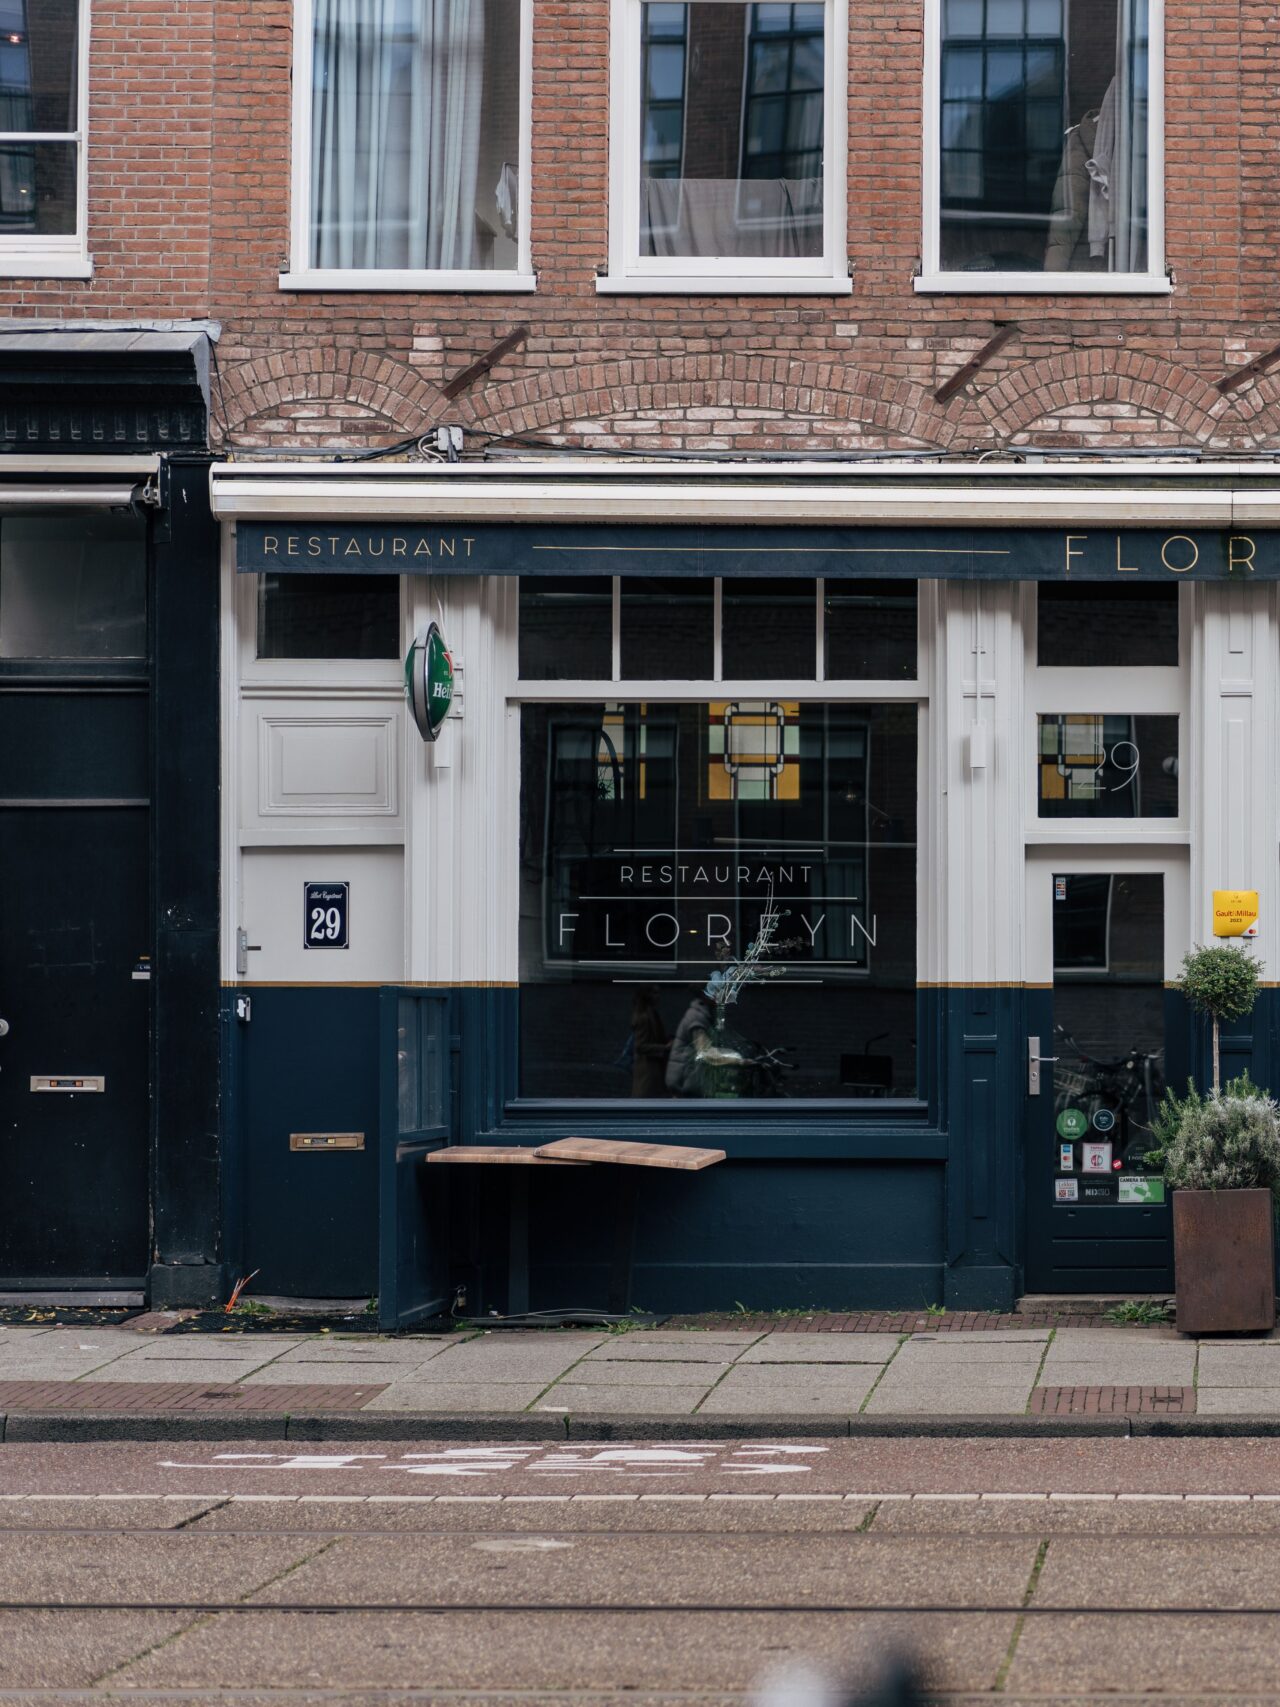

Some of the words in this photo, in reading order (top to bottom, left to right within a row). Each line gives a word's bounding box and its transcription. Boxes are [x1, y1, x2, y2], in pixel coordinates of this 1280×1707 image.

[263, 536, 476, 556] RESTAURANT
[1077, 740, 1140, 792] 29
[619, 865, 813, 884] RESTAURANT
[311, 907, 340, 939] 29
[559, 912, 877, 948] FLOREYN
